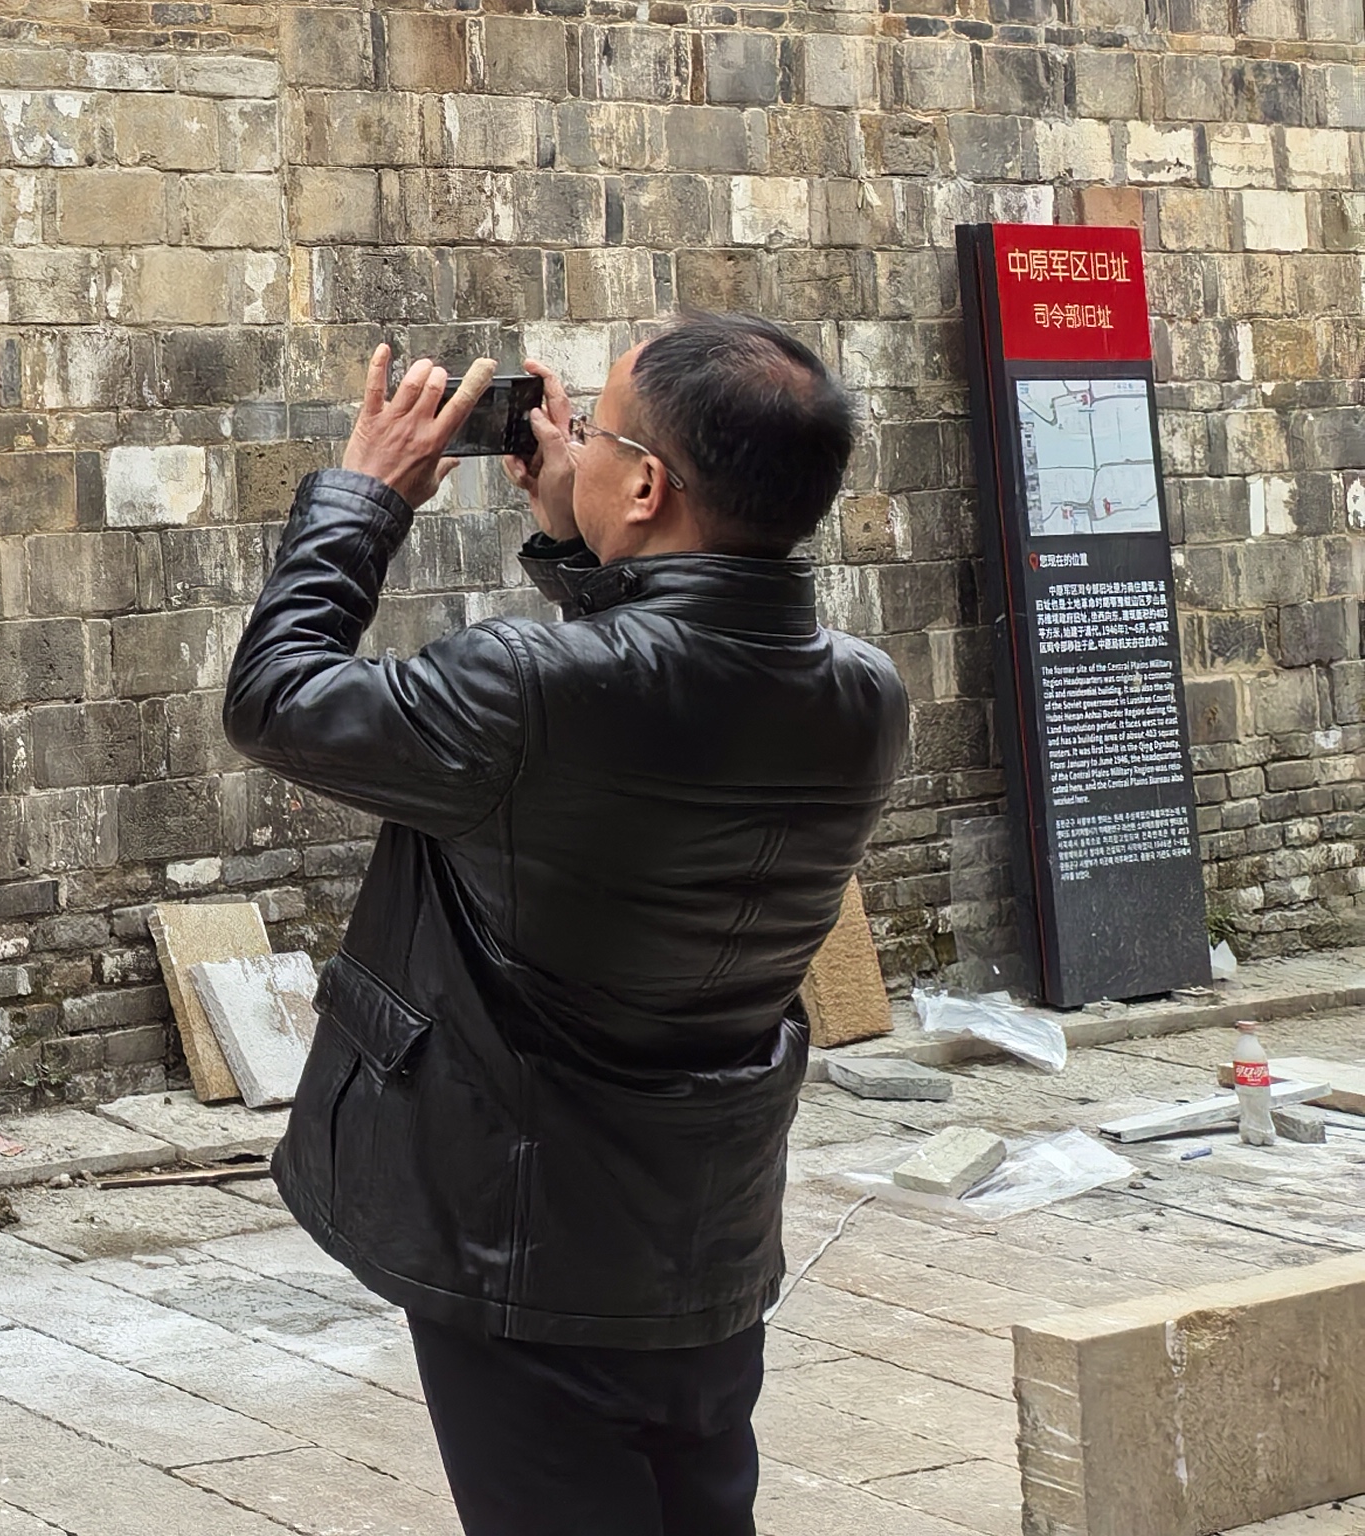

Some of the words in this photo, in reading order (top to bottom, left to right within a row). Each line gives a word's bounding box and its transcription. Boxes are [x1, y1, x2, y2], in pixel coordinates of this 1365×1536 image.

[1007, 248, 1131, 282] 中原军区旧址
[1033, 303, 1114, 329] 司令部旧址
[1042, 666, 1053, 675] The
[1054, 665, 1075, 674] former
[1077, 664, 1087, 672] site
[1089, 664, 1095, 672] of
[1096, 663, 1106, 671] the
[1108, 662, 1129, 671] Central
[1131, 661, 1148, 669] Plains
[1150, 659, 1172, 670] Military
[1043, 678, 1062, 688] Region
[1063, 675, 1103, 687] Headquarters
[1055, 689, 1065, 697] and
[1067, 687, 1097, 696] residential
[1141, 683, 1152, 691] also
[1154, 682, 1163, 690] the
[1164, 682, 1175, 690] site
[1045, 702, 1051, 710] of
[1052, 701, 1062, 709] the
[1063, 700, 1081, 709] Soviet
[1083, 698, 1119, 709] government
[1103, 709, 1123, 717] Border
[1125, 707, 1144, 717] Region
[1146, 706, 1165, 716] during
[1166, 705, 1177, 713] the
[1047, 725, 1061, 733] Land
[1063, 723, 1095, 732] Revolution
[1125, 719, 1141, 727] faces
[1165, 716, 1178, 724] east
[1048, 737, 1059, 745] and
[1078, 734, 1103, 744] building
[1119, 732, 1125, 740] of
[1092, 746, 1103, 754] first
[1105, 745, 1118, 753] built
[1127, 743, 1137, 751] the
[1139, 742, 1152, 751] Qing
[1050, 761, 1065, 769] From
[1067, 759, 1089, 769] January
[1098, 757, 1113, 765] June
[1131, 754, 1140, 762] the
[1142, 751, 1182, 762] headquarters
[1051, 773, 1057, 781] of
[1058, 772, 1068, 780] the
[1069, 770, 1090, 779] Central
[1092, 769, 1109, 777] Plains
[1110, 767, 1133, 777] Military
[1134, 765, 1154, 775] Region
[1085, 782, 1096, 790] and
[1108, 779, 1129, 787] Central
[1130, 777, 1148, 785] Plains
[1171, 773, 1184, 781] also
